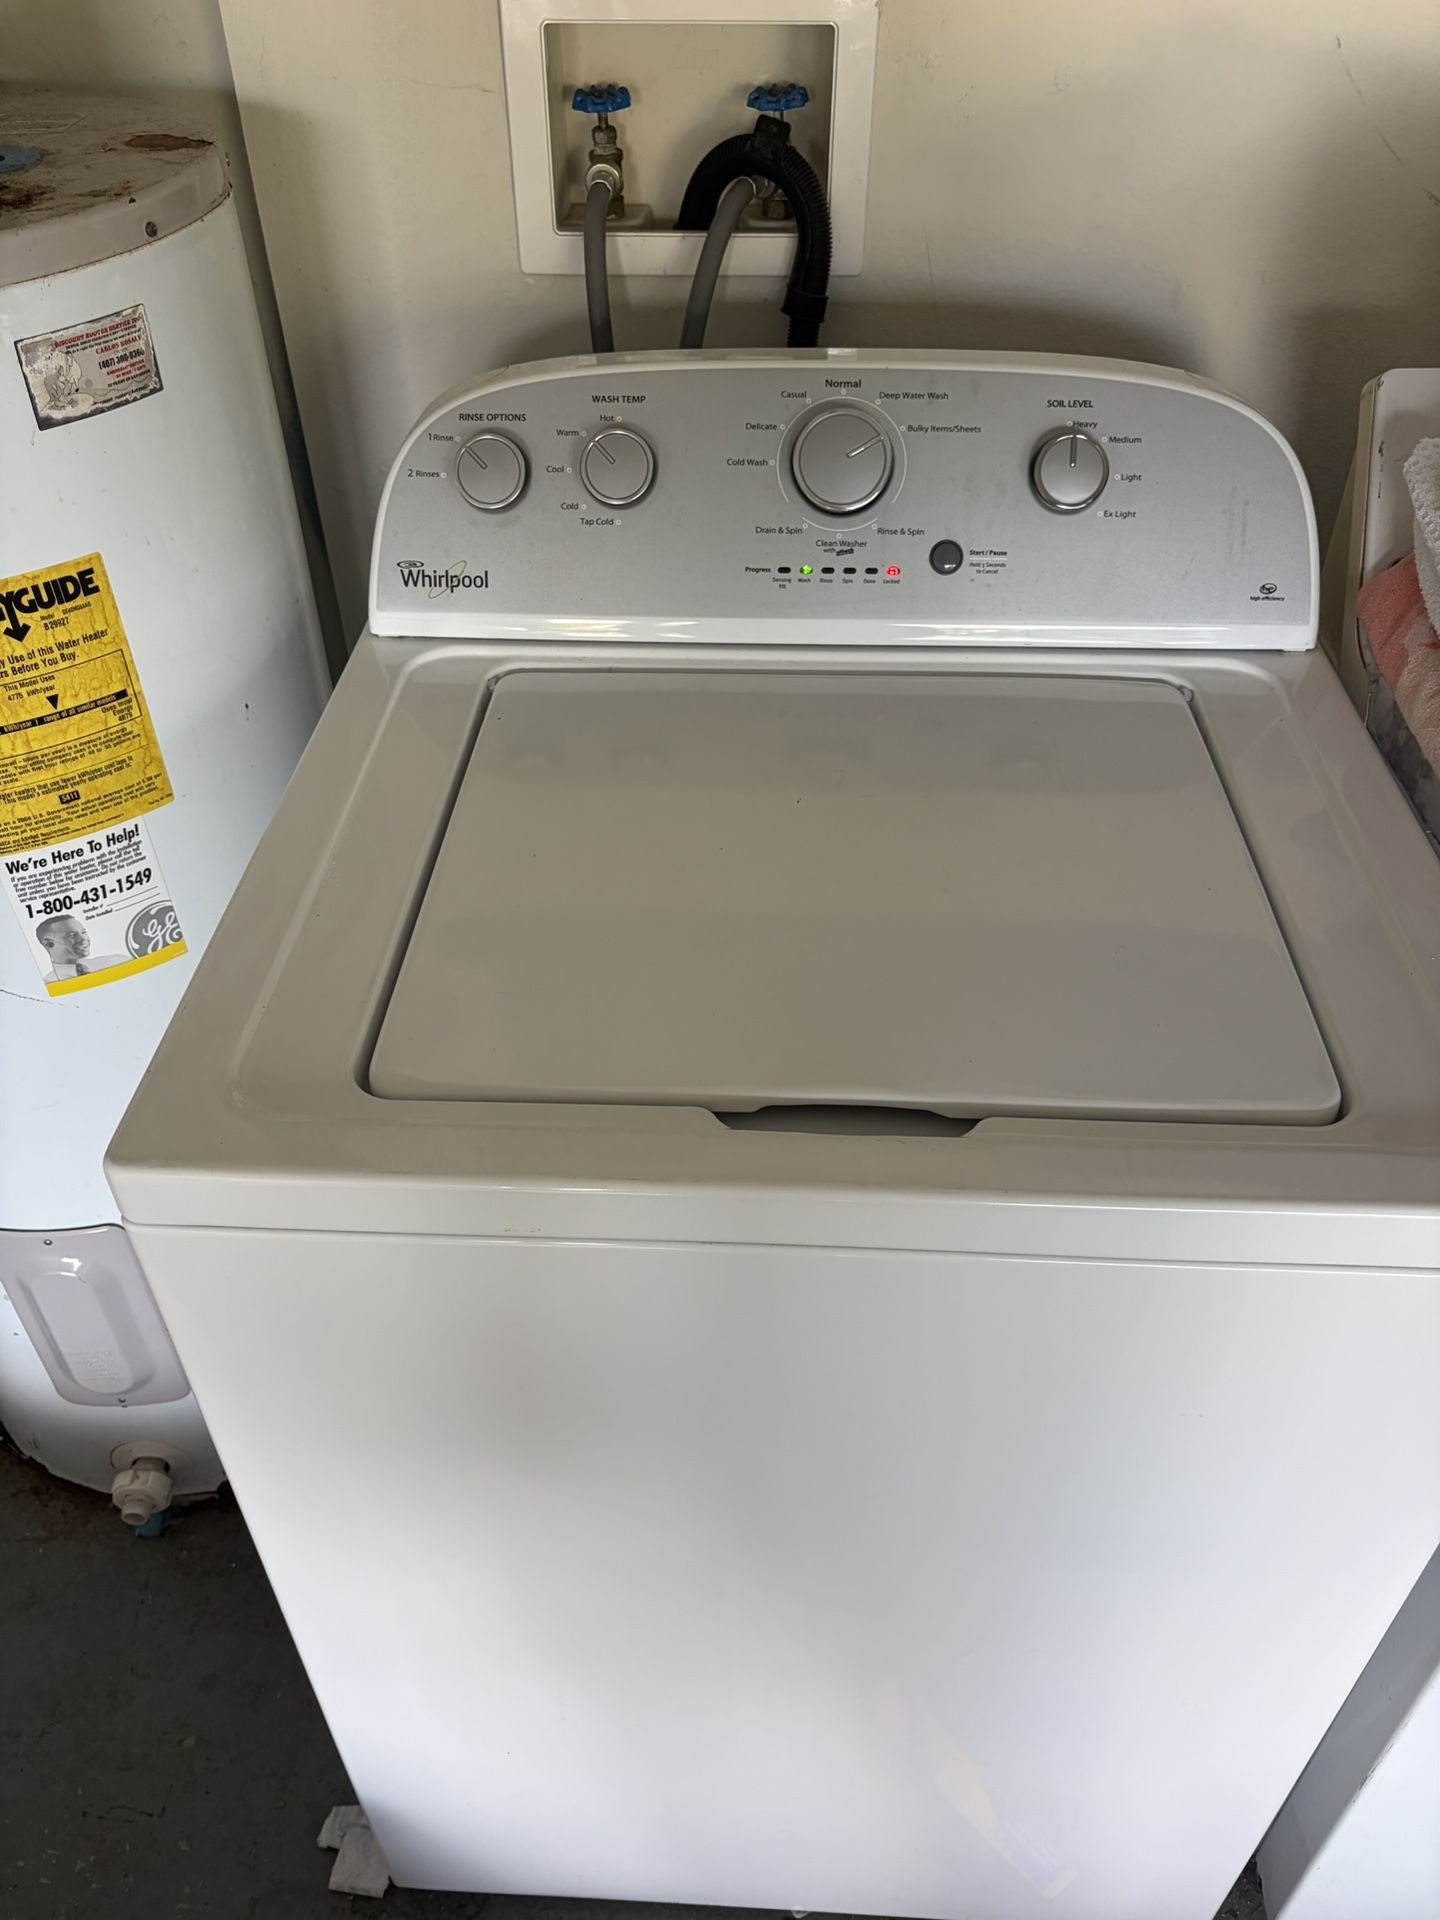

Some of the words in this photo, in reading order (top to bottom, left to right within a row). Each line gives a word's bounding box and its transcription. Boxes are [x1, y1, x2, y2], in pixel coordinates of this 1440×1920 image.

[85, 327, 108, 337] ROOTER
[108, 320, 131, 332] SERVICE
[95, 343, 119, 354] CARLOS
[98, 357, 115, 370] (407)
[824, 379, 862, 389] Normal
[591, 395, 620, 404] WASH
[621, 395, 646, 404] TEMP
[780, 390, 807, 399] Casual
[879, 391, 900, 401] Deep
[902, 391, 926, 400] Water
[927, 391, 949, 400] Wash
[1047, 400, 1066, 408] SOIL
[1068, 400, 1094, 408] LEVEL
[458, 413, 485, 422] RINSE
[486, 413, 527, 422] OPTIONS
[600, 414, 615, 423] Hot
[745, 422, 778, 431] Delicate
[907, 424, 930, 434] Bulky
[930, 424, 982, 434] Items/Sheets
[1072, 420, 1098, 429] Heavy
[428, 432, 432, 441] 1
[433, 433, 454, 442] Rinse
[556, 429, 579, 437] Warm
[1109, 436, 1142, 444] Medium
[726, 458, 746, 467] Cold
[746, 458, 768, 467] Wash
[407, 469, 413, 478] 2
[415, 469, 440, 479] Rinses
[546, 465, 565, 474] Cool
[1121, 474, 1142, 482] Light
[560, 502, 579, 511] Cold
[1104, 510, 1113, 518] Ex
[1114, 510, 1136, 519] Light
[580, 518, 595, 527] Tap
[596, 517, 614, 526] Cold
[755, 526, 776, 535] Drain
[777, 526, 784, 535] &
[785, 526, 803, 536] Spin
[877, 527, 898, 536] Rinse
[899, 527, 906, 536] &
[907, 527, 925, 537] Spin
[815, 539, 837, 548] Clean
[839, 540, 868, 549] Washer
[400, 569, 489, 593] Whirlpool
[40, 613, 55, 621] Model
[43, 617, 69, 631] B29927
[7, 653, 25, 665] Use
[27, 649, 36, 660] of
[37, 645, 54, 657] this
[55, 638, 80, 651] Water
[82, 628, 108, 644] Heater
[11, 661, 40, 676] Before
[41, 656, 58, 668] You
[60, 651, 80, 663] Buy.
[19, 678, 39, 689] Model
[40, 674, 55, 684] Uses
[8, 692, 23, 701] 4775
[26, 685, 55, 697] kWh/year
[43, 713, 60, 723] range
[77, 701, 96, 712] similar
[96, 694, 117, 706] models
[101, 704, 117, 714] Uses
[117, 697, 133, 706] most
[112, 704, 133, 716] Energy
[5, 857, 48, 874] We're
[51, 847, 84, 864] Here
[86, 838, 102, 852] To
[106, 824, 140, 847] Help!
[126, 856, 146, 866] customer
[39, 865, 71, 876] experiencing
[72, 857, 95, 867] problems
[20, 877, 45, 887] operation
[63, 867, 78, 875] water
[98, 857, 113, 866] please
[28, 882, 47, 890] number
[49, 877, 64, 885] below
[25, 867, 152, 918] 1-800-431-1549
